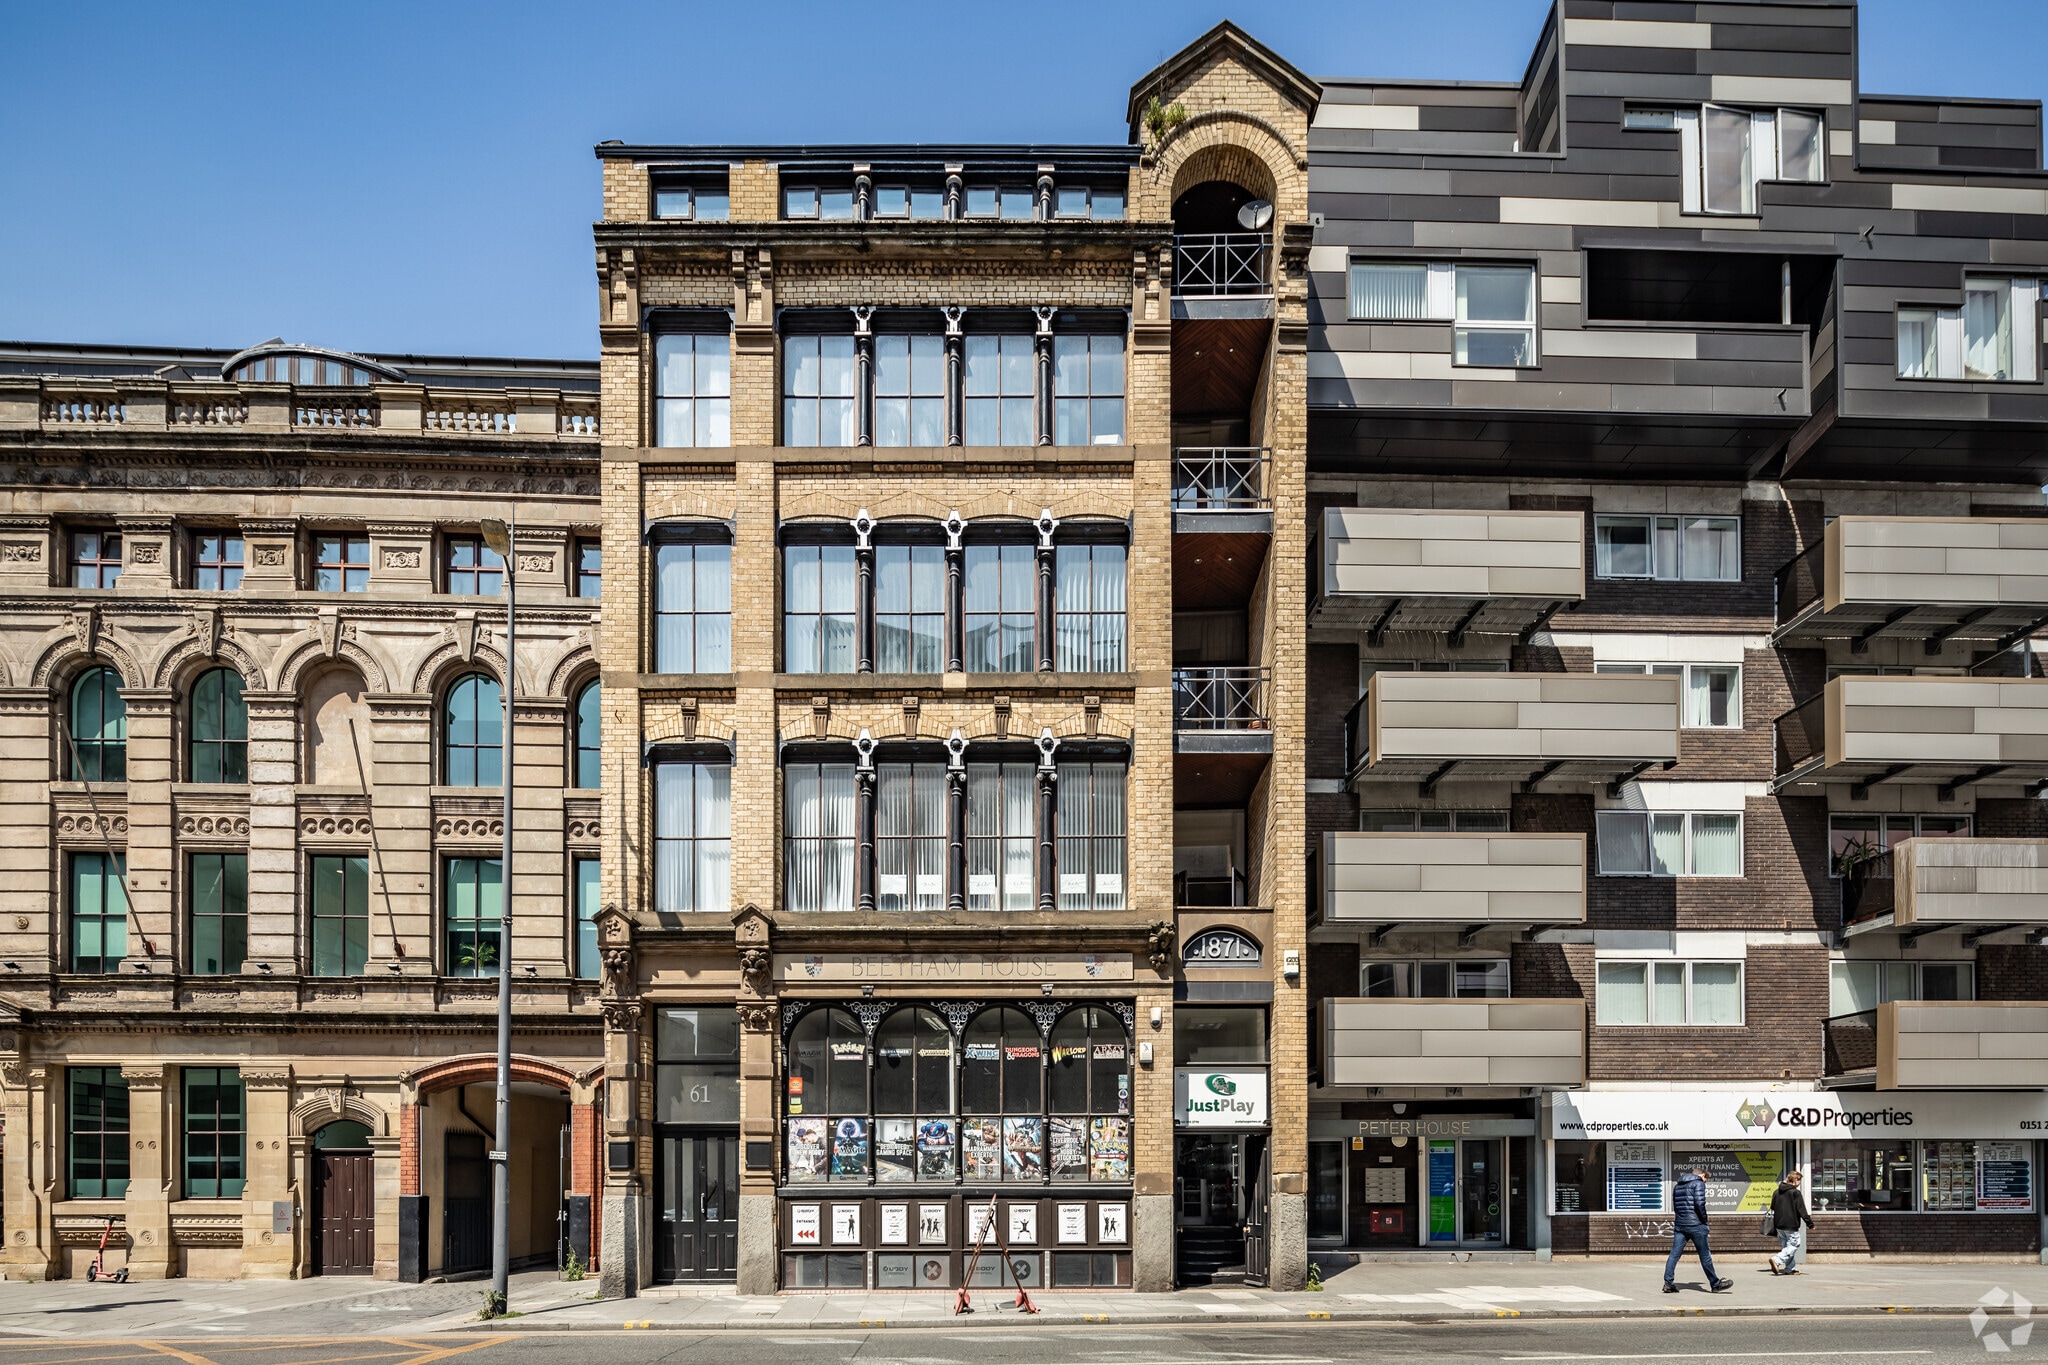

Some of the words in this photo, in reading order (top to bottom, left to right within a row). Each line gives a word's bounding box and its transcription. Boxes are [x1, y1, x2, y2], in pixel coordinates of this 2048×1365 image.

[1201, 936, 1240, 958] 1871
[851, 956, 961, 977] BEETHAM
[980, 956, 1057, 977] HOUSE
[690, 1084, 711, 1103] 61
[1186, 1099, 1255, 1116] JustPlay
[1777, 1107, 1821, 1127] C&D
[1823, 1107, 1913, 1130] Properties
[2020, 1120, 2042, 1130] 0151
[1358, 1121, 1411, 1135] PETER
[1415, 1121, 1471, 1135] HOUSE
[1560, 1121, 1669, 1133] www.cdproperties.co.uk
[1673, 1163, 1709, 1171] PROPERTY
[1717, 1188, 1739, 1198] 2900
